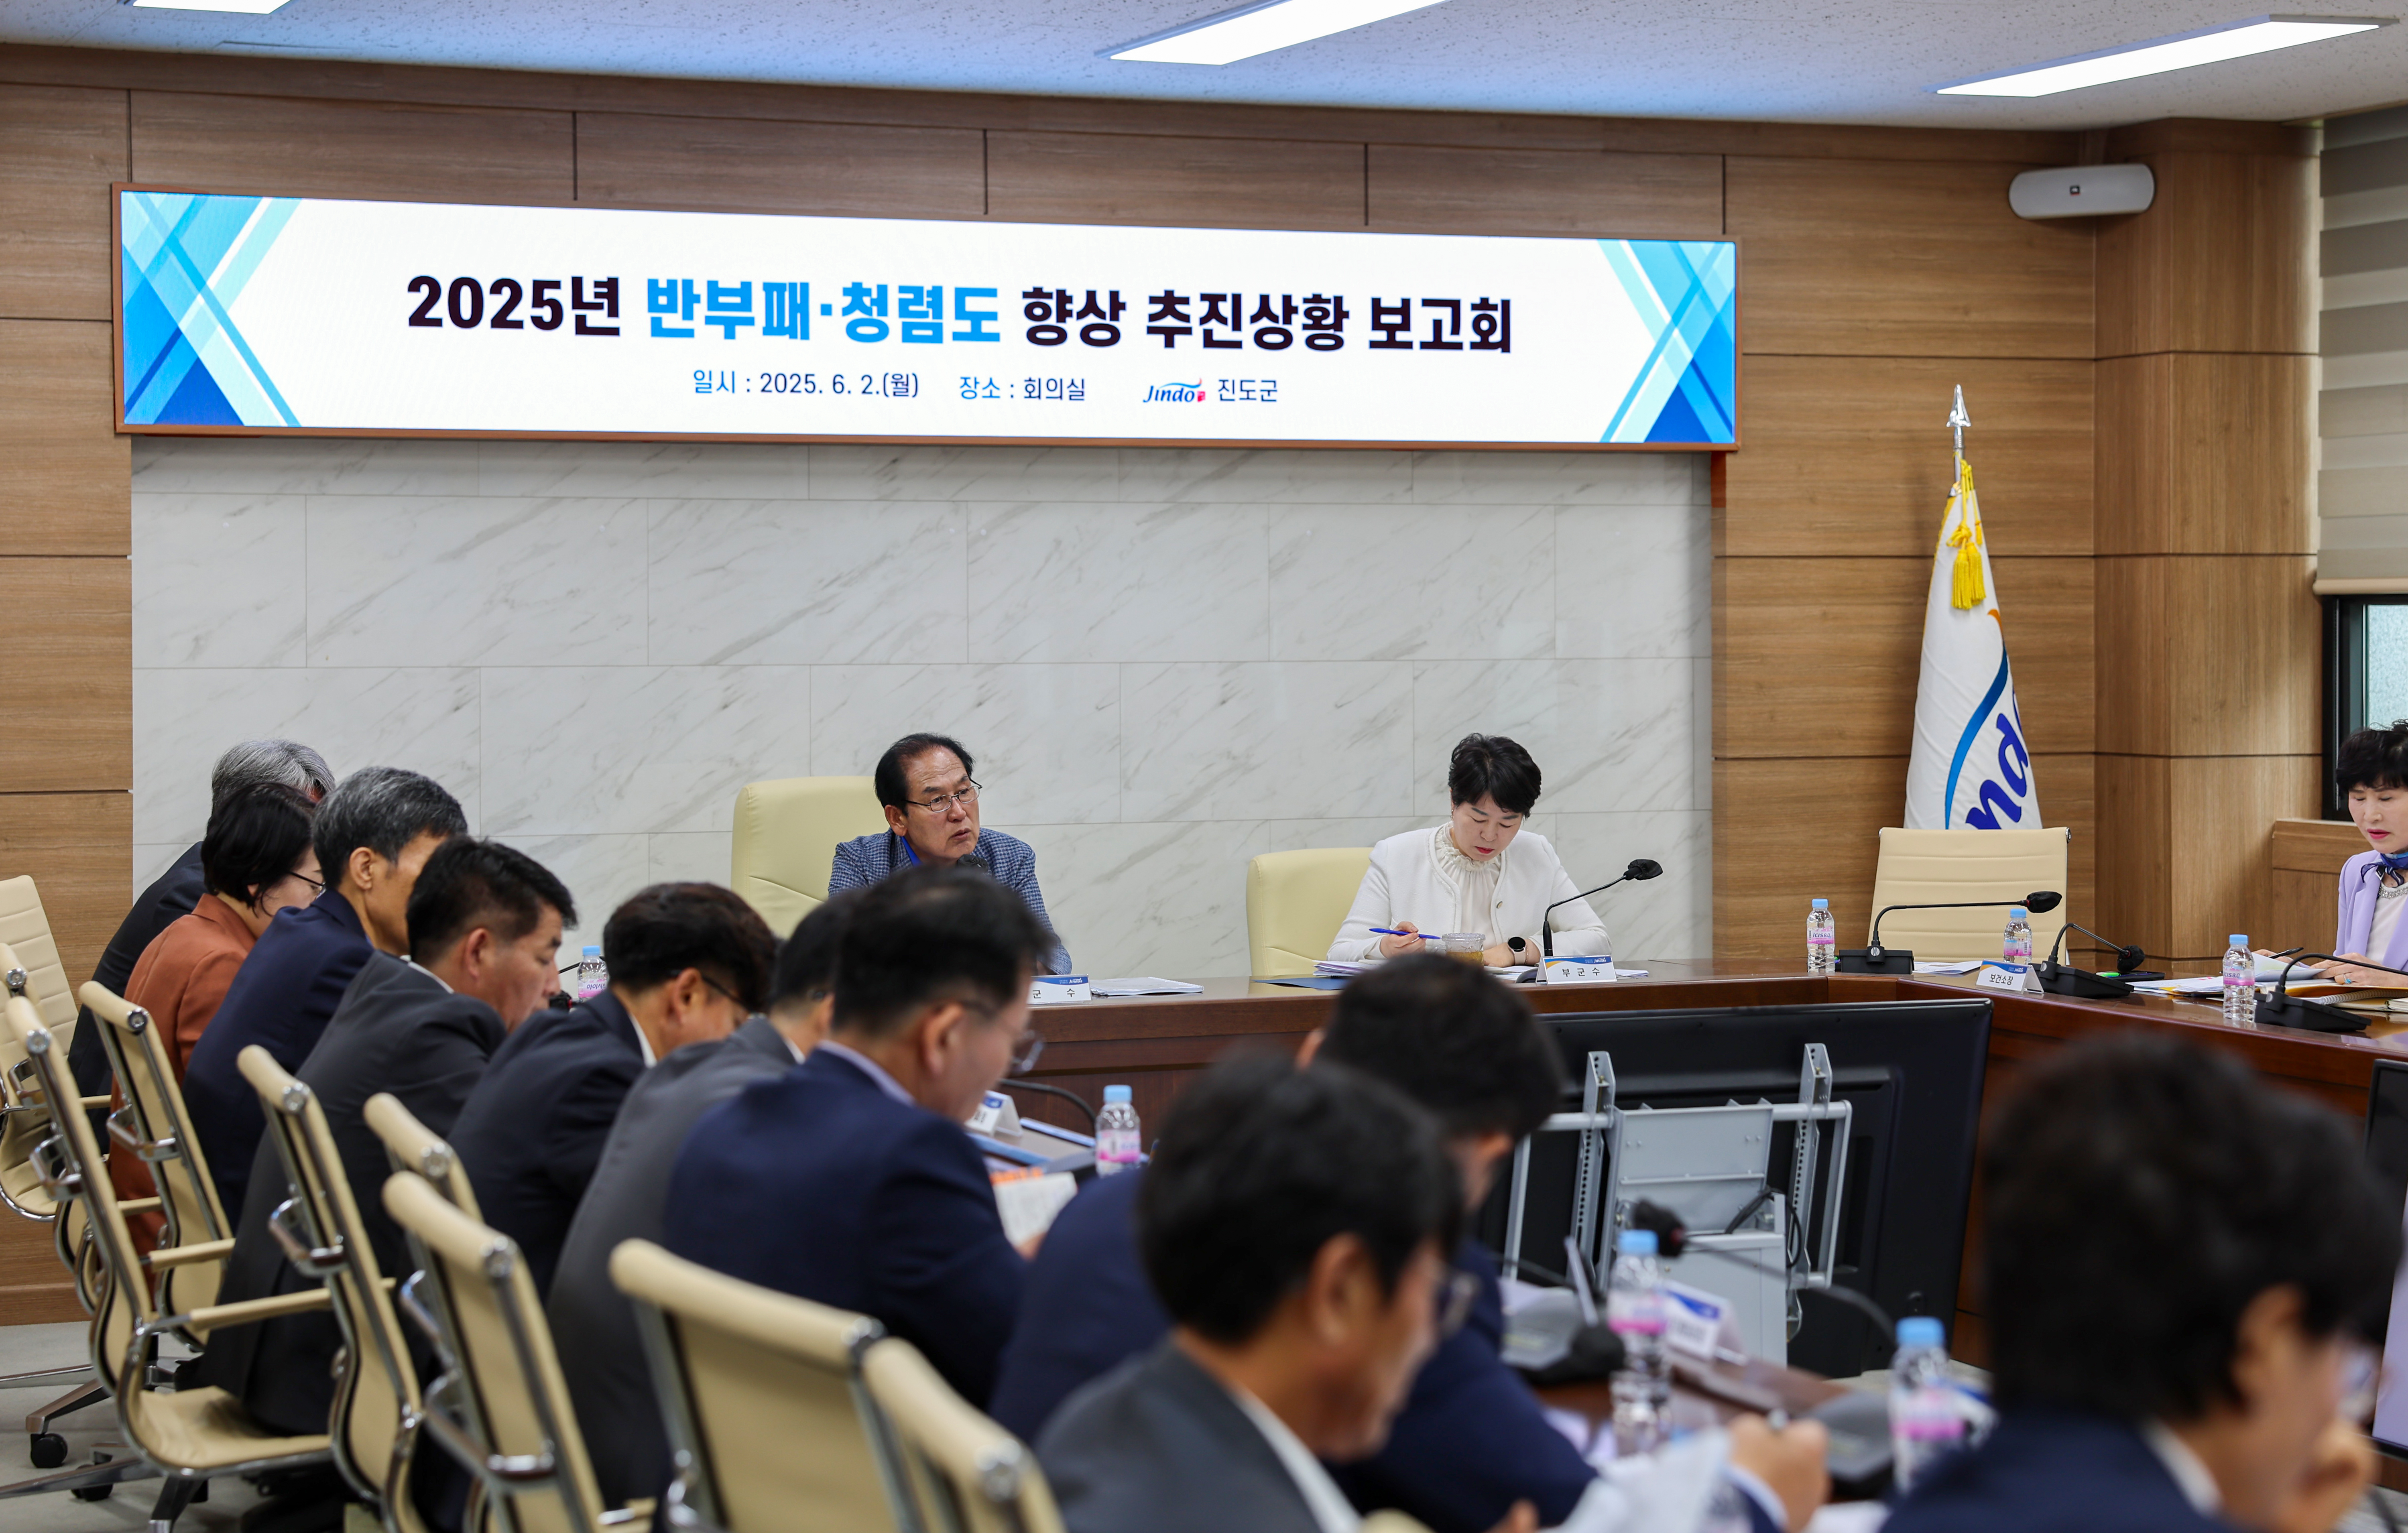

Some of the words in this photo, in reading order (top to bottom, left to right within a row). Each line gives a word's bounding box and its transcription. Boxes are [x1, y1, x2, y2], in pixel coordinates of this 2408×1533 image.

[407, 275, 620, 337] 2025년
[647, 278, 1001, 344] 반부패·청렴도
[1021, 286, 1127, 348] 향상
[1146, 289, 1350, 352] 추진상황
[1368, 297, 1511, 354] 보고회
[694, 370, 735, 394] 일시
[746, 378, 750, 393] :
[761, 372, 822, 394] 2025.
[833, 374, 851, 394] 6.
[861, 372, 919, 398] 2.(월)
[960, 376, 1001, 400] 장소
[1010, 384, 1014, 399] :
[1023, 376, 1085, 401] 회의실
[1143, 382, 1197, 403] Jindo
[1218, 379, 1278, 402] 진도군
[1989, 974, 2013, 985] 보건소장
